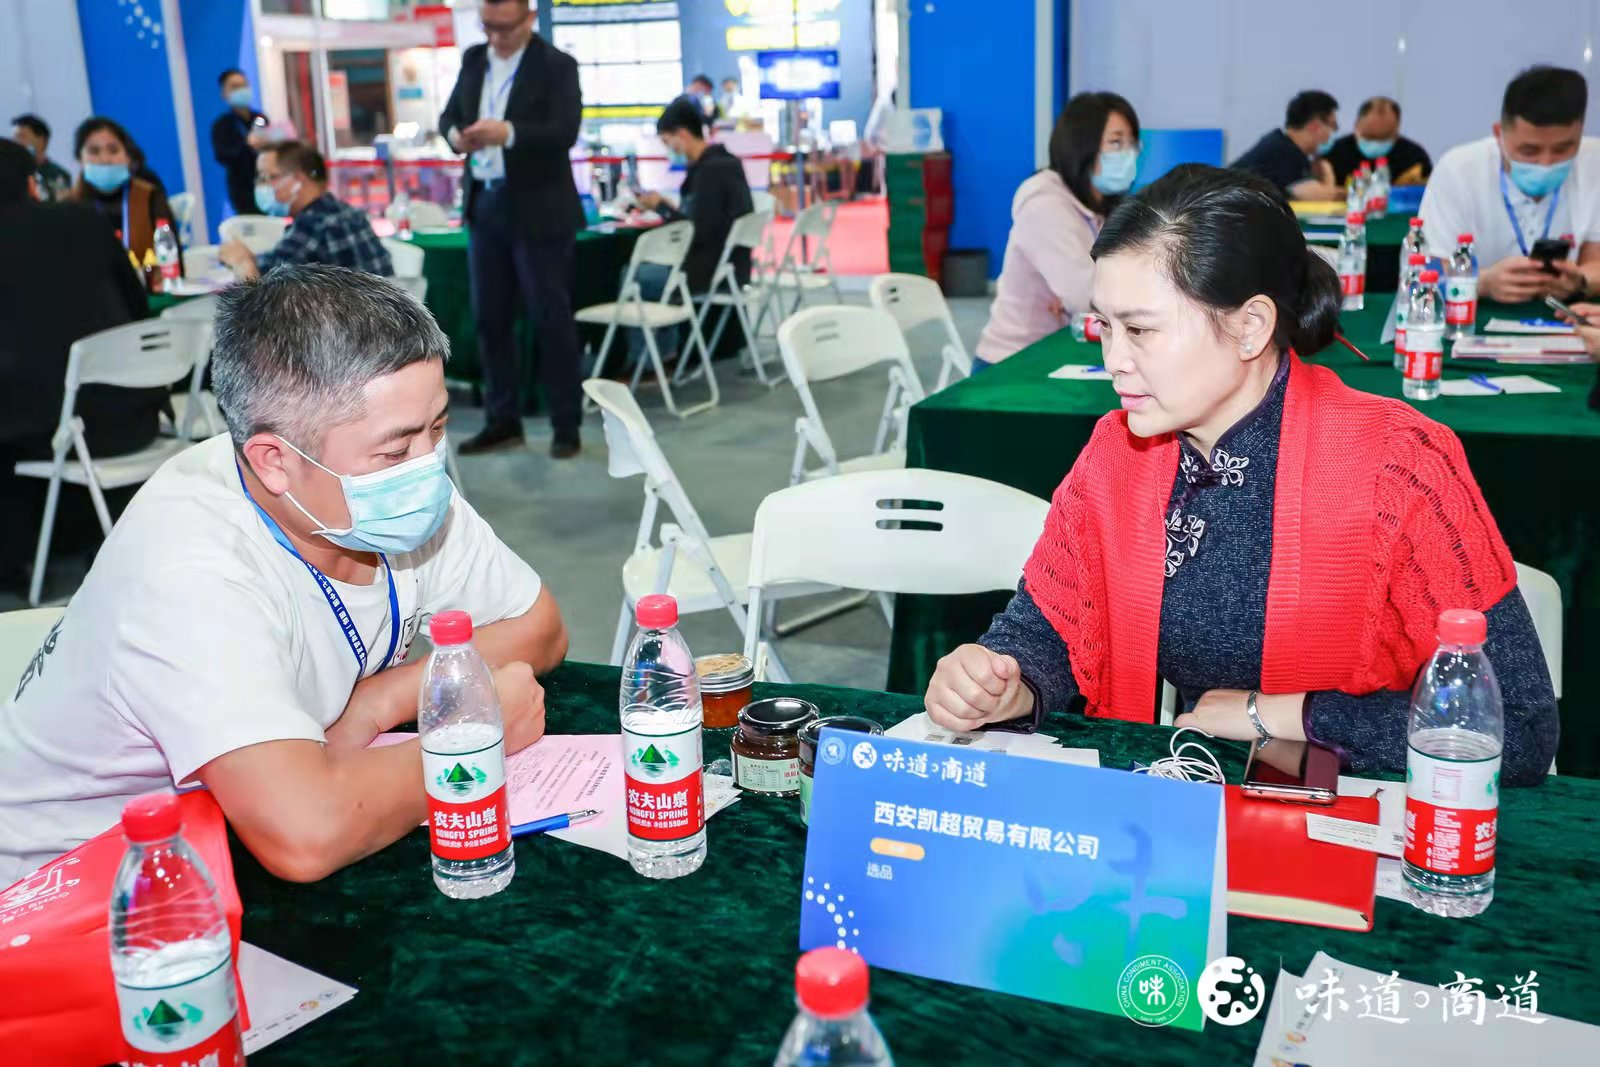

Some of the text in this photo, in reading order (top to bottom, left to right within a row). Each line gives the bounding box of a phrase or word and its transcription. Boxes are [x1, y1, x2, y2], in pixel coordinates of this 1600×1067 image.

[628, 789, 688, 810] 农夫山泉
[434, 805, 497, 829] 农夫山泉
[657, 808, 688, 820] SPRING
[468, 824, 498, 839] SPRING
[873, 800, 1100, 860] 西安凯超贸易有限公司
